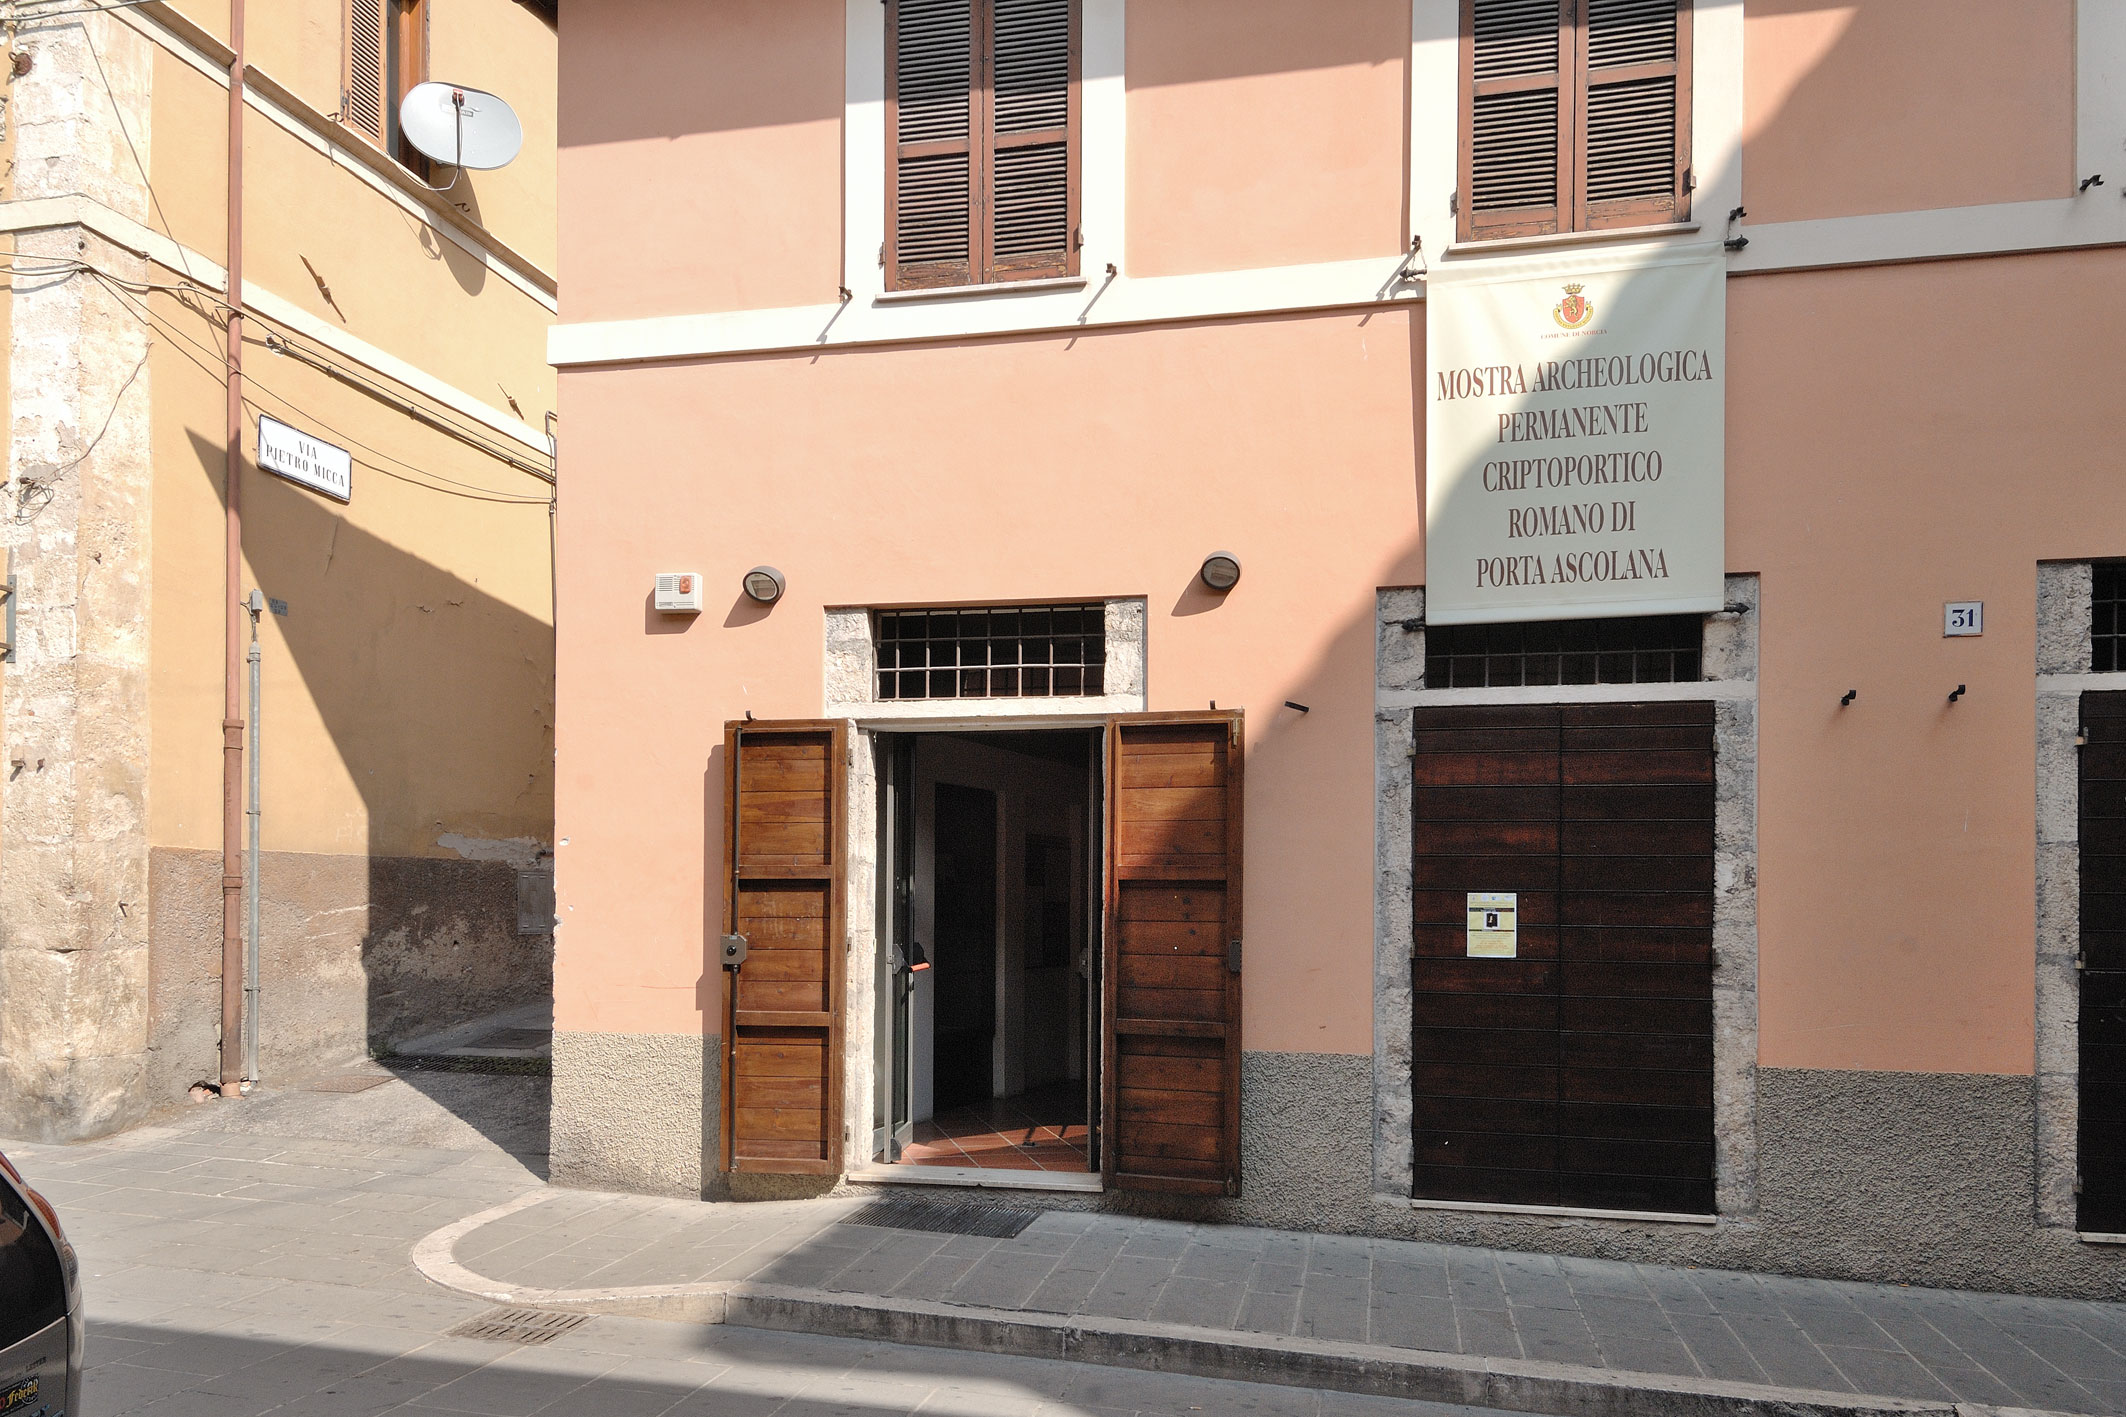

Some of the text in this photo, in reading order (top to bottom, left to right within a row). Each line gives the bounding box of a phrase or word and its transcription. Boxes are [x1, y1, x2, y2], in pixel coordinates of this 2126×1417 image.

[1582, 328, 1608, 337] NORCIA
[1437, 349, 1713, 401] MOSTRA ARCHEOLOGICA
[1497, 402, 1649, 443] PERMANENTE
[266, 444, 345, 488] PIETRO MICCA
[299, 440, 318, 460] VIA
[1483, 450, 1663, 493] CRIPTOPORTICO
[1508, 501, 1637, 539] ROMANO DI
[1476, 548, 1670, 588] PORTA ASCOLANA
[1951, 608, 1974, 628] 31
